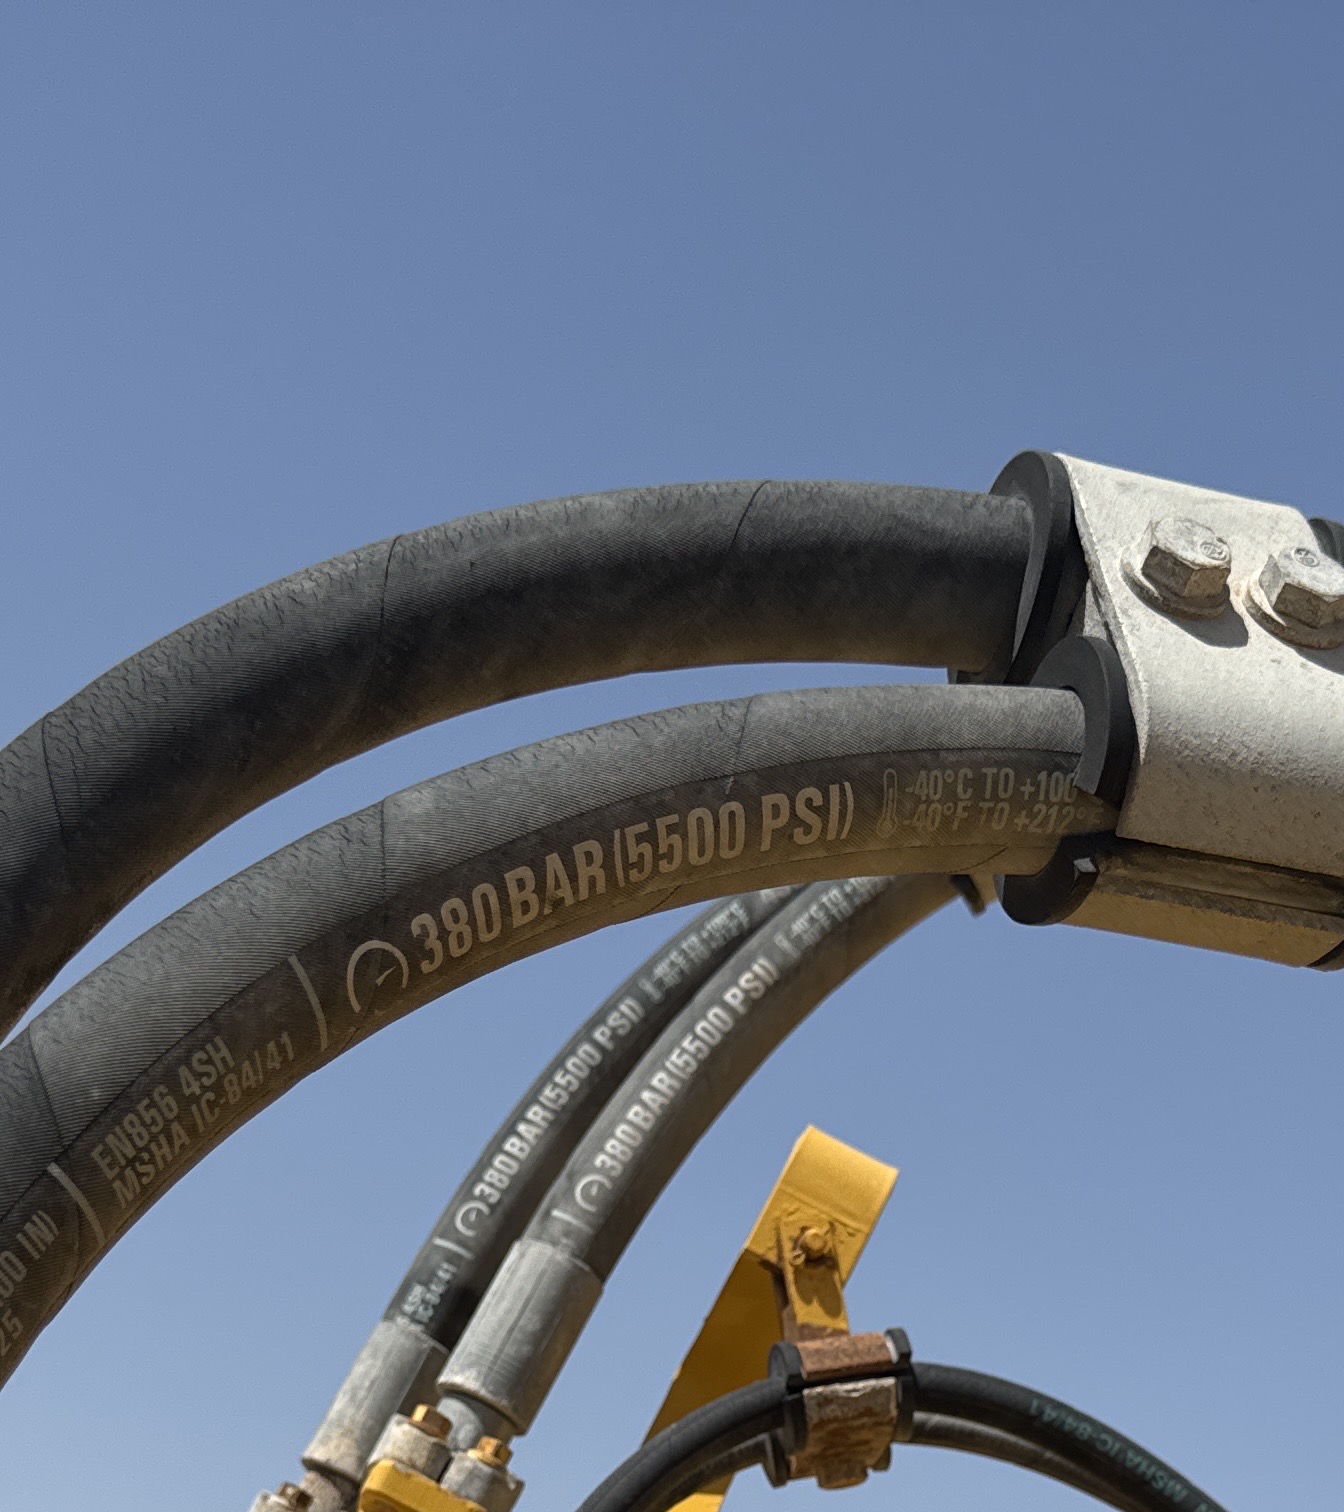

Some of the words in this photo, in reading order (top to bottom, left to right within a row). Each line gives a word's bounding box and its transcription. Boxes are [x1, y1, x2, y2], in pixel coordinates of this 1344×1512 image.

[906, 768, 973, 800] -40°C
[981, 767, 1014, 799] TO
[760, 781, 854, 851] PSI)
[905, 802, 972, 832] -40°F
[978, 802, 1010, 831] TO
[91, 1085, 180, 1180] EN856
[179, 1036, 235, 1098] 4SH
[111, 1122, 190, 1209] MSHA
[193, 1032, 295, 1134] IC-84/41
[16, 1210, 61, 1262] IN)
[1123, 1450, 1189, 1502] MSHA
